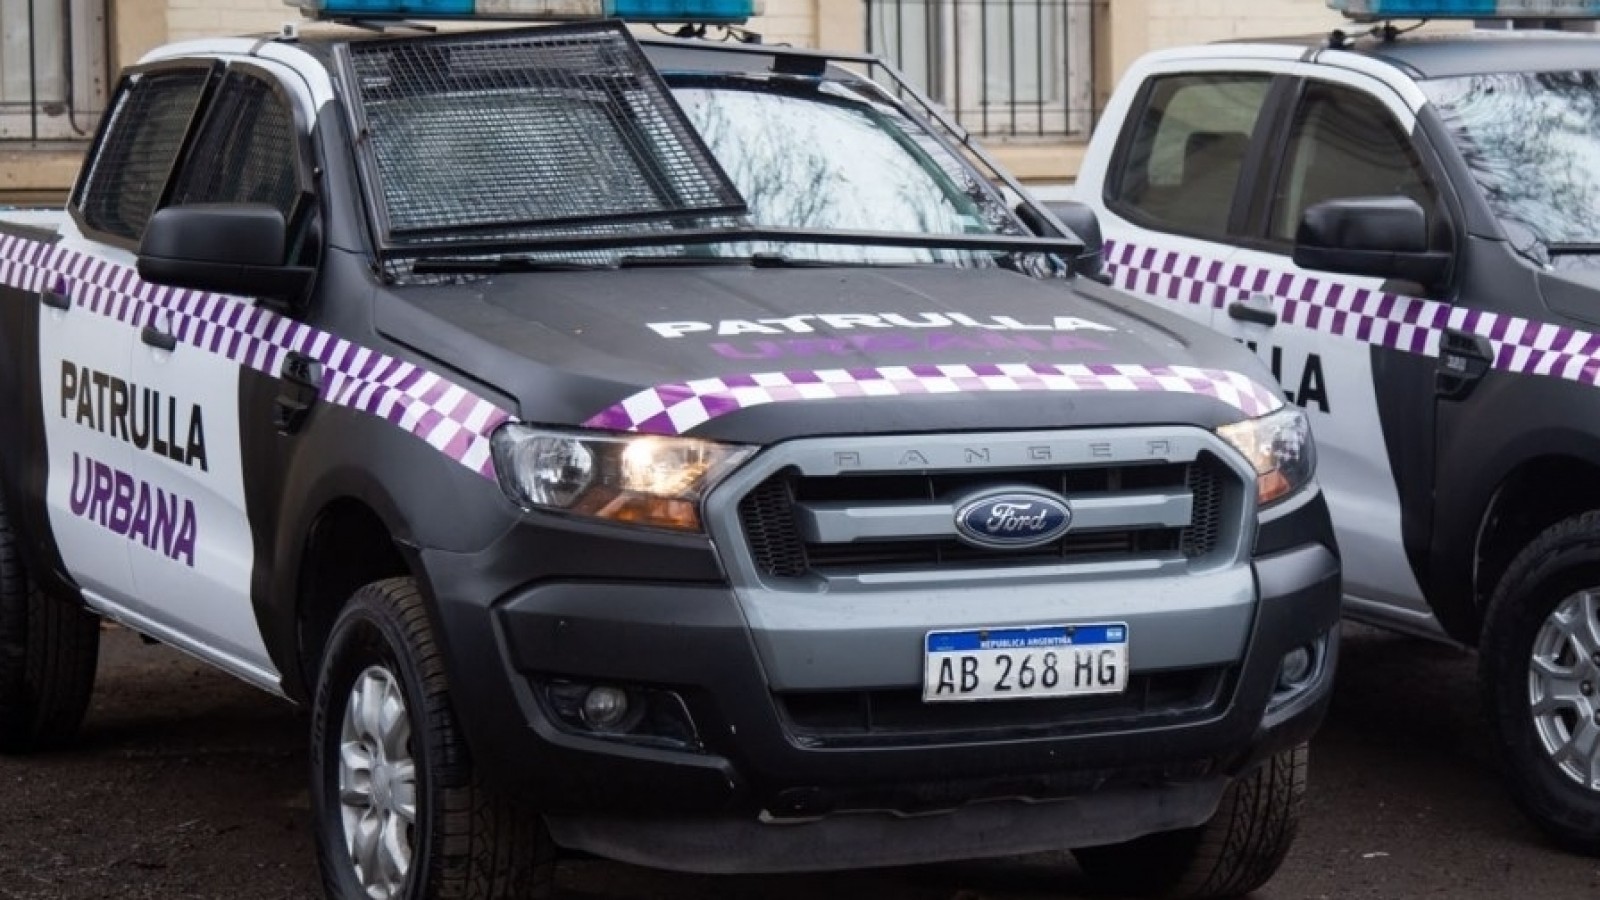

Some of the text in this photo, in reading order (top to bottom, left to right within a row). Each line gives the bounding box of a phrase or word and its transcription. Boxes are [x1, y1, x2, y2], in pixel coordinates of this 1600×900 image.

[647, 312, 1117, 338] PATRULLA
[710, 332, 1110, 360] URBANA
[60, 358, 208, 473] PATRULLA
[833, 440, 1171, 466] RANGER
[69, 451, 197, 568] URBANA
[986, 502, 1048, 532] Ford
[936, 649, 1117, 695] AB 268 HG
